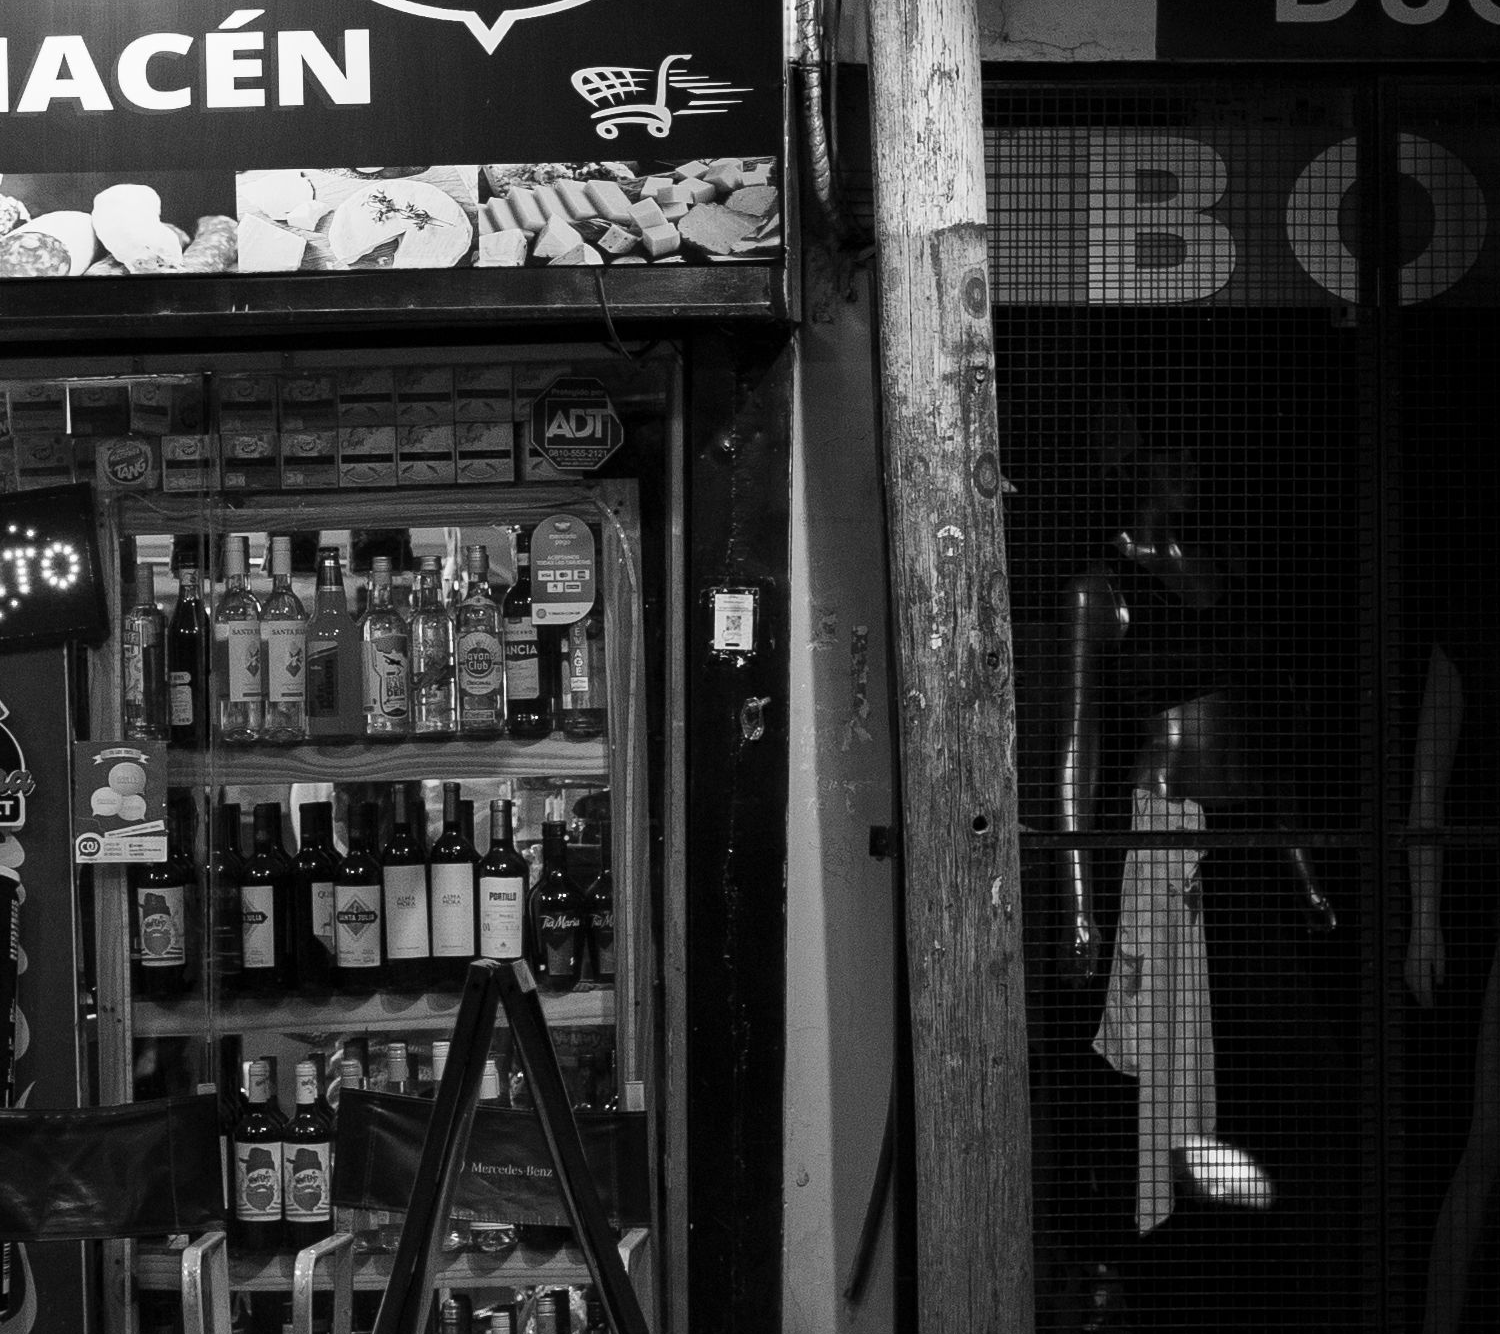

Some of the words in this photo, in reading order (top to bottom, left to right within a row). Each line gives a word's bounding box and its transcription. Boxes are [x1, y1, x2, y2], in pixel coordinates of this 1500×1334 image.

[546, 408, 610, 438] ADT
[114, 459, 146, 480] TANG
[506, 644, 538, 655] ANCIA
[468, 661, 488, 670] Club
[489, 892, 517, 902] PORTILLO
[471, 1161, 553, 1178] Mercedes-Benz
